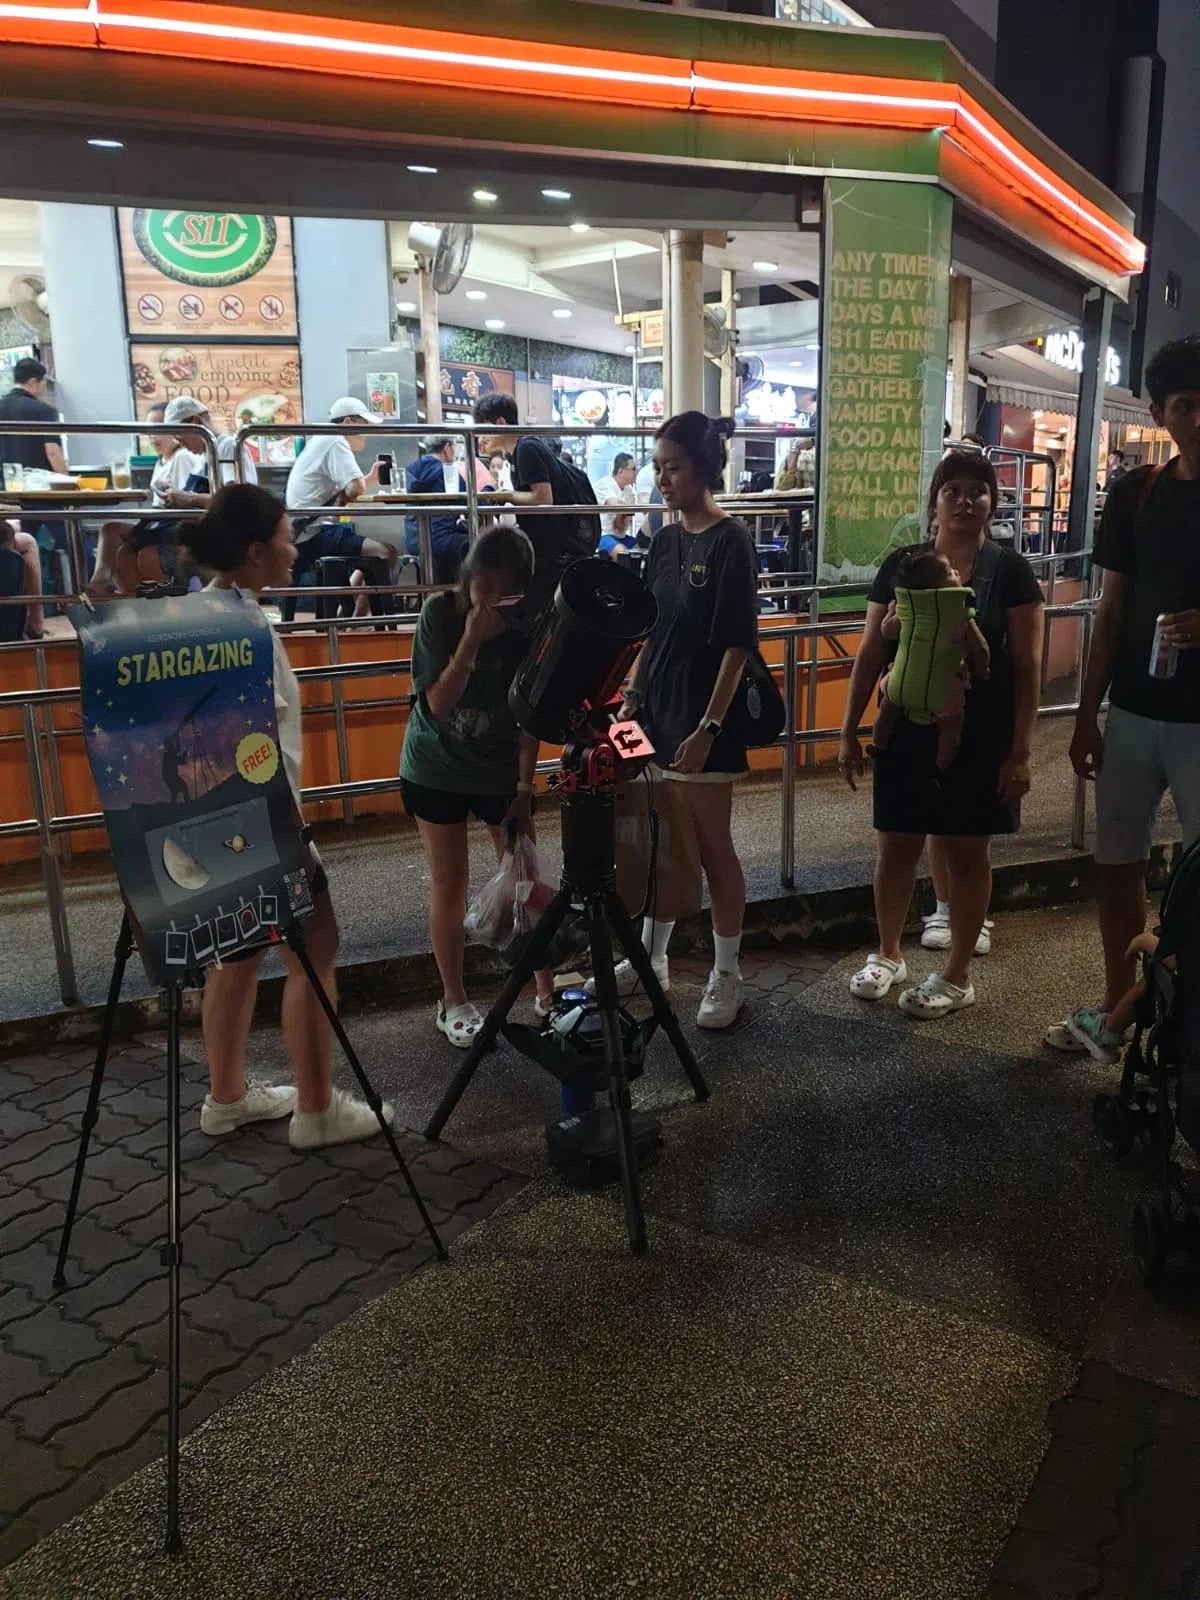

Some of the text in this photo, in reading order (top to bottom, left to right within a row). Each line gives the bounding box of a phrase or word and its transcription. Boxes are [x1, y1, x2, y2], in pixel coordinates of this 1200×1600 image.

[179, 214, 231, 246] S11
[833, 252, 876, 273] ANY
[834, 278, 872, 298] THE
[879, 278, 918, 300] DAY
[832, 303, 883, 325] DAYS
[890, 304, 905, 325] A
[832, 354, 902, 374] HOUSE
[201, 370, 273, 387] enjoying
[830, 377, 912, 399] GATHER
[164, 385, 231, 405] FOOD
[830, 402, 912, 424] VARIETY
[830, 426, 886, 448] FOOD
[117, 637, 253, 687] STARGAZING
[242, 742, 272, 776] FREE!
